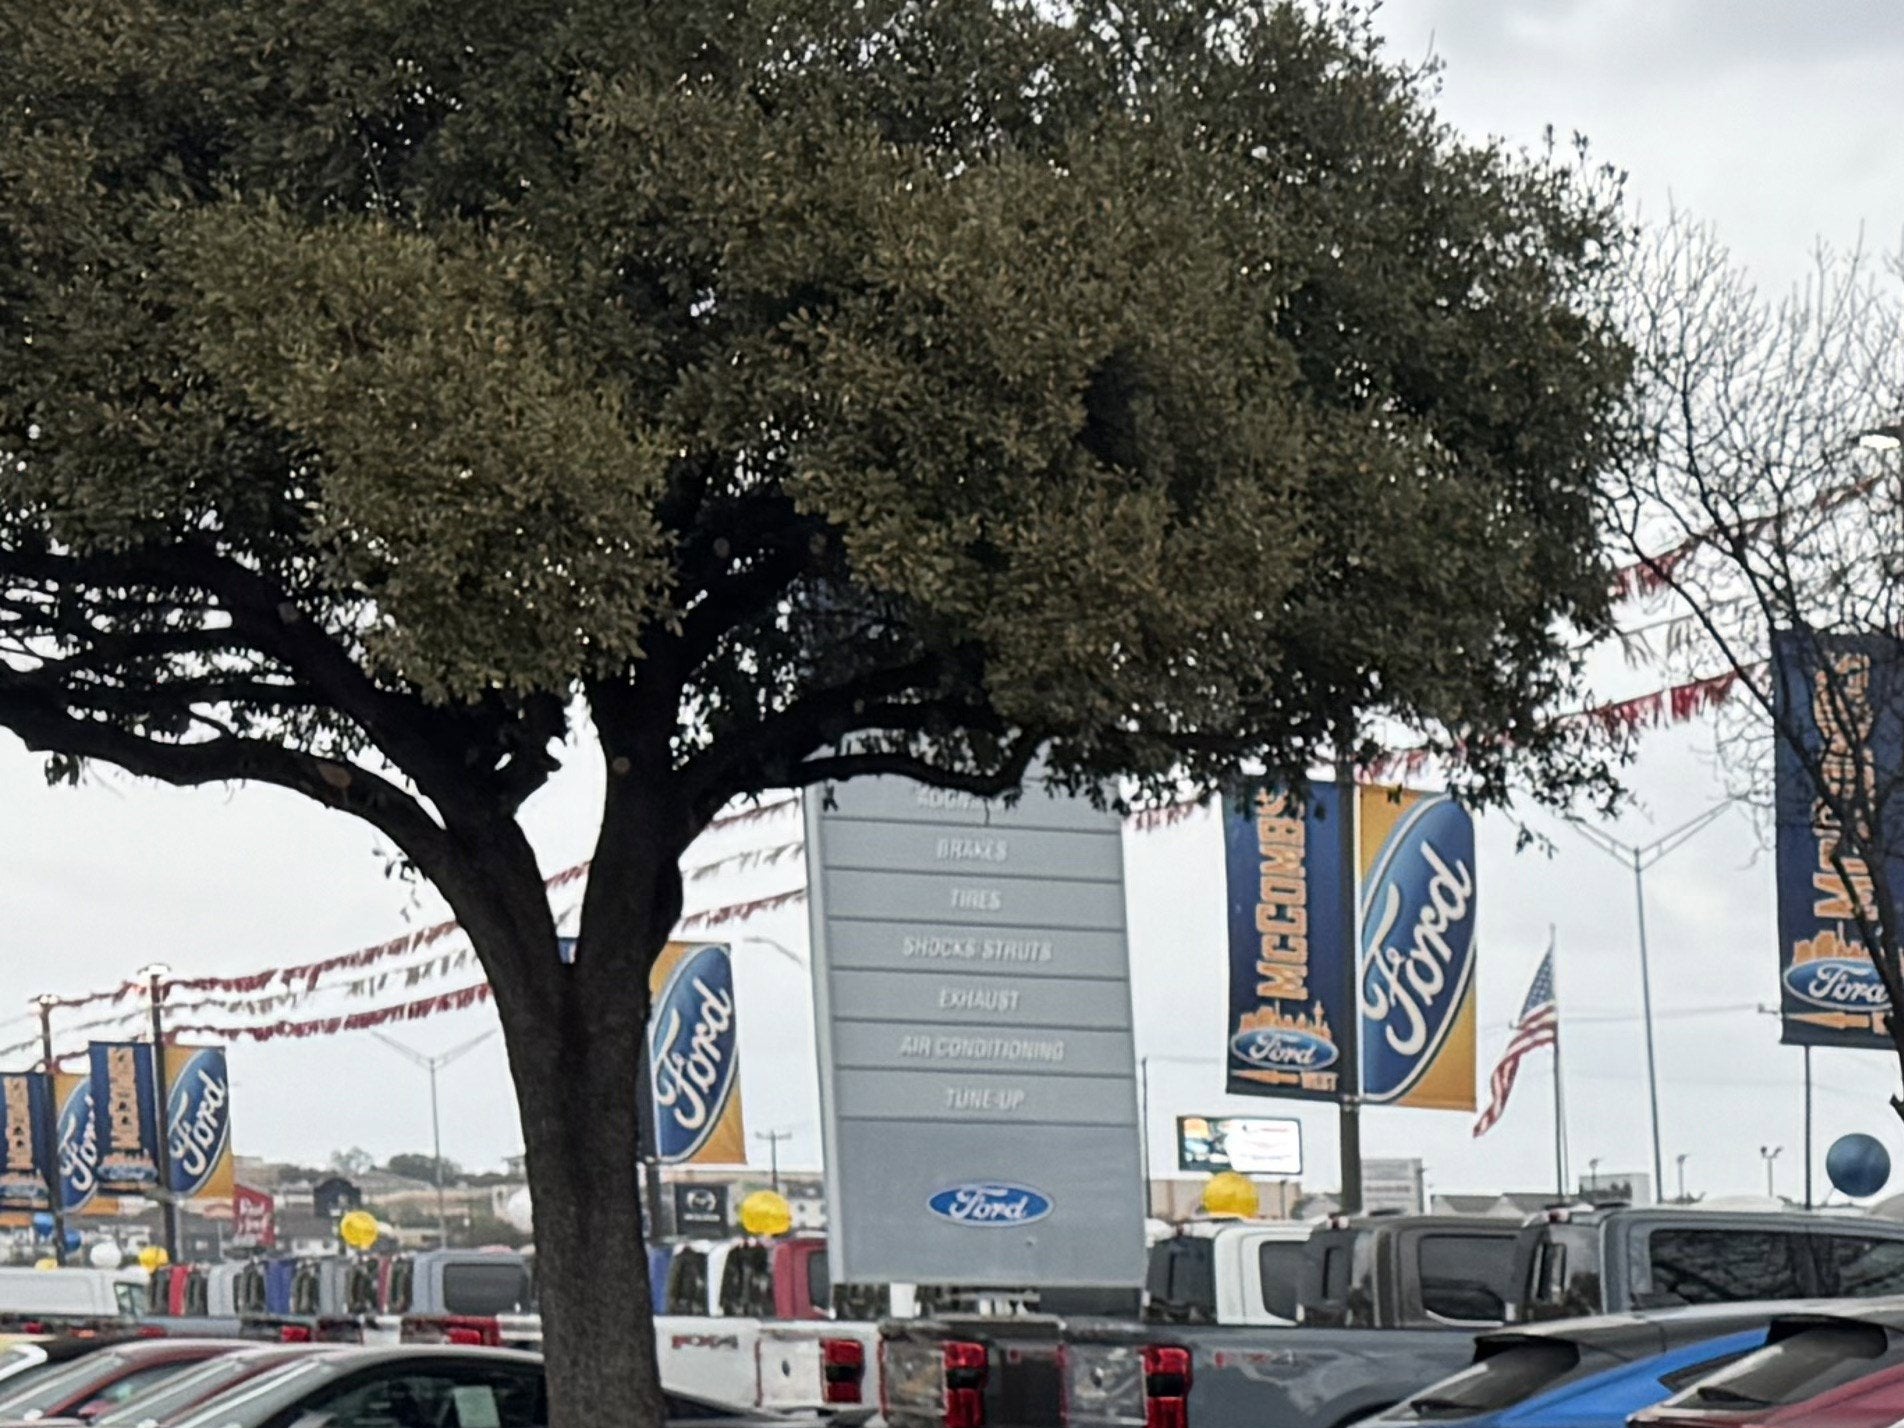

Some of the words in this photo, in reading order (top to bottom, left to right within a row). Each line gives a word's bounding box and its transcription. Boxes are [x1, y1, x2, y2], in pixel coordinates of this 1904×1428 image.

[951, 889, 1001, 910] TIRES
[1363, 840, 1474, 1056] Ford
[939, 989, 1020, 1011] EXHAUST
[656, 977, 732, 1130] Ford
[900, 1036, 931, 1056] AIR
[935, 1036, 1065, 1061] CONDITIONING
[1249, 1034, 1317, 1064] Ford
[947, 1088, 1025, 1110] TUNE-UP
[169, 1067, 227, 1176] Ford
[949, 1186, 1027, 1223] Ford
